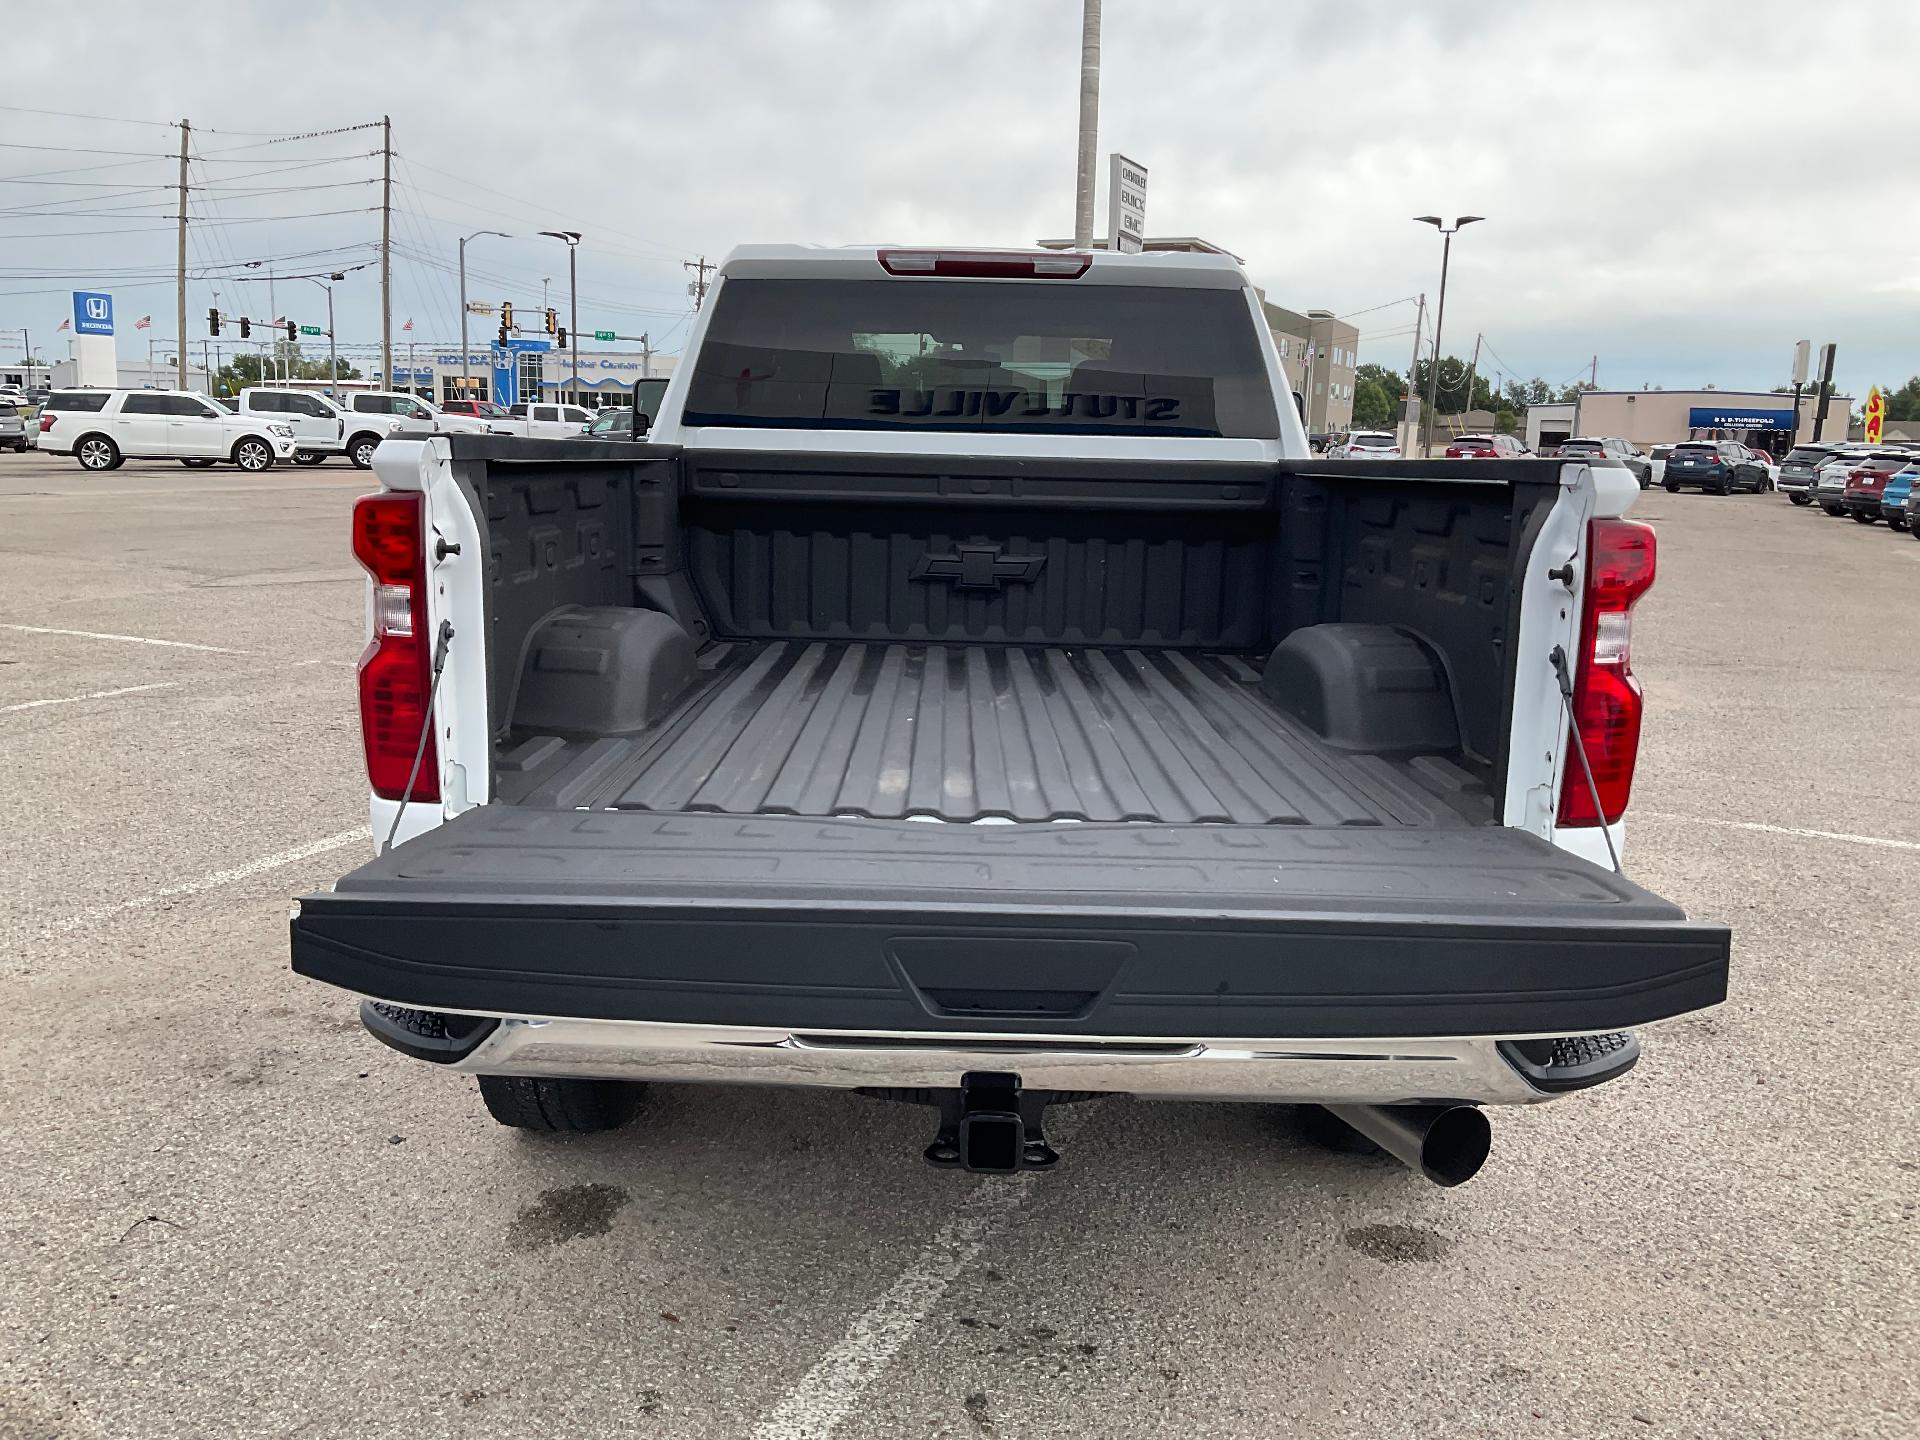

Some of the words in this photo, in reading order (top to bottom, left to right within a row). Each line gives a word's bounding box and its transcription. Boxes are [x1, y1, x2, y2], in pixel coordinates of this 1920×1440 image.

[1121, 189, 1145, 212] BUICK
[81, 322, 113, 330] HONDA
[392, 365, 421, 374] Servce
[1867, 394, 1882, 443] SA
